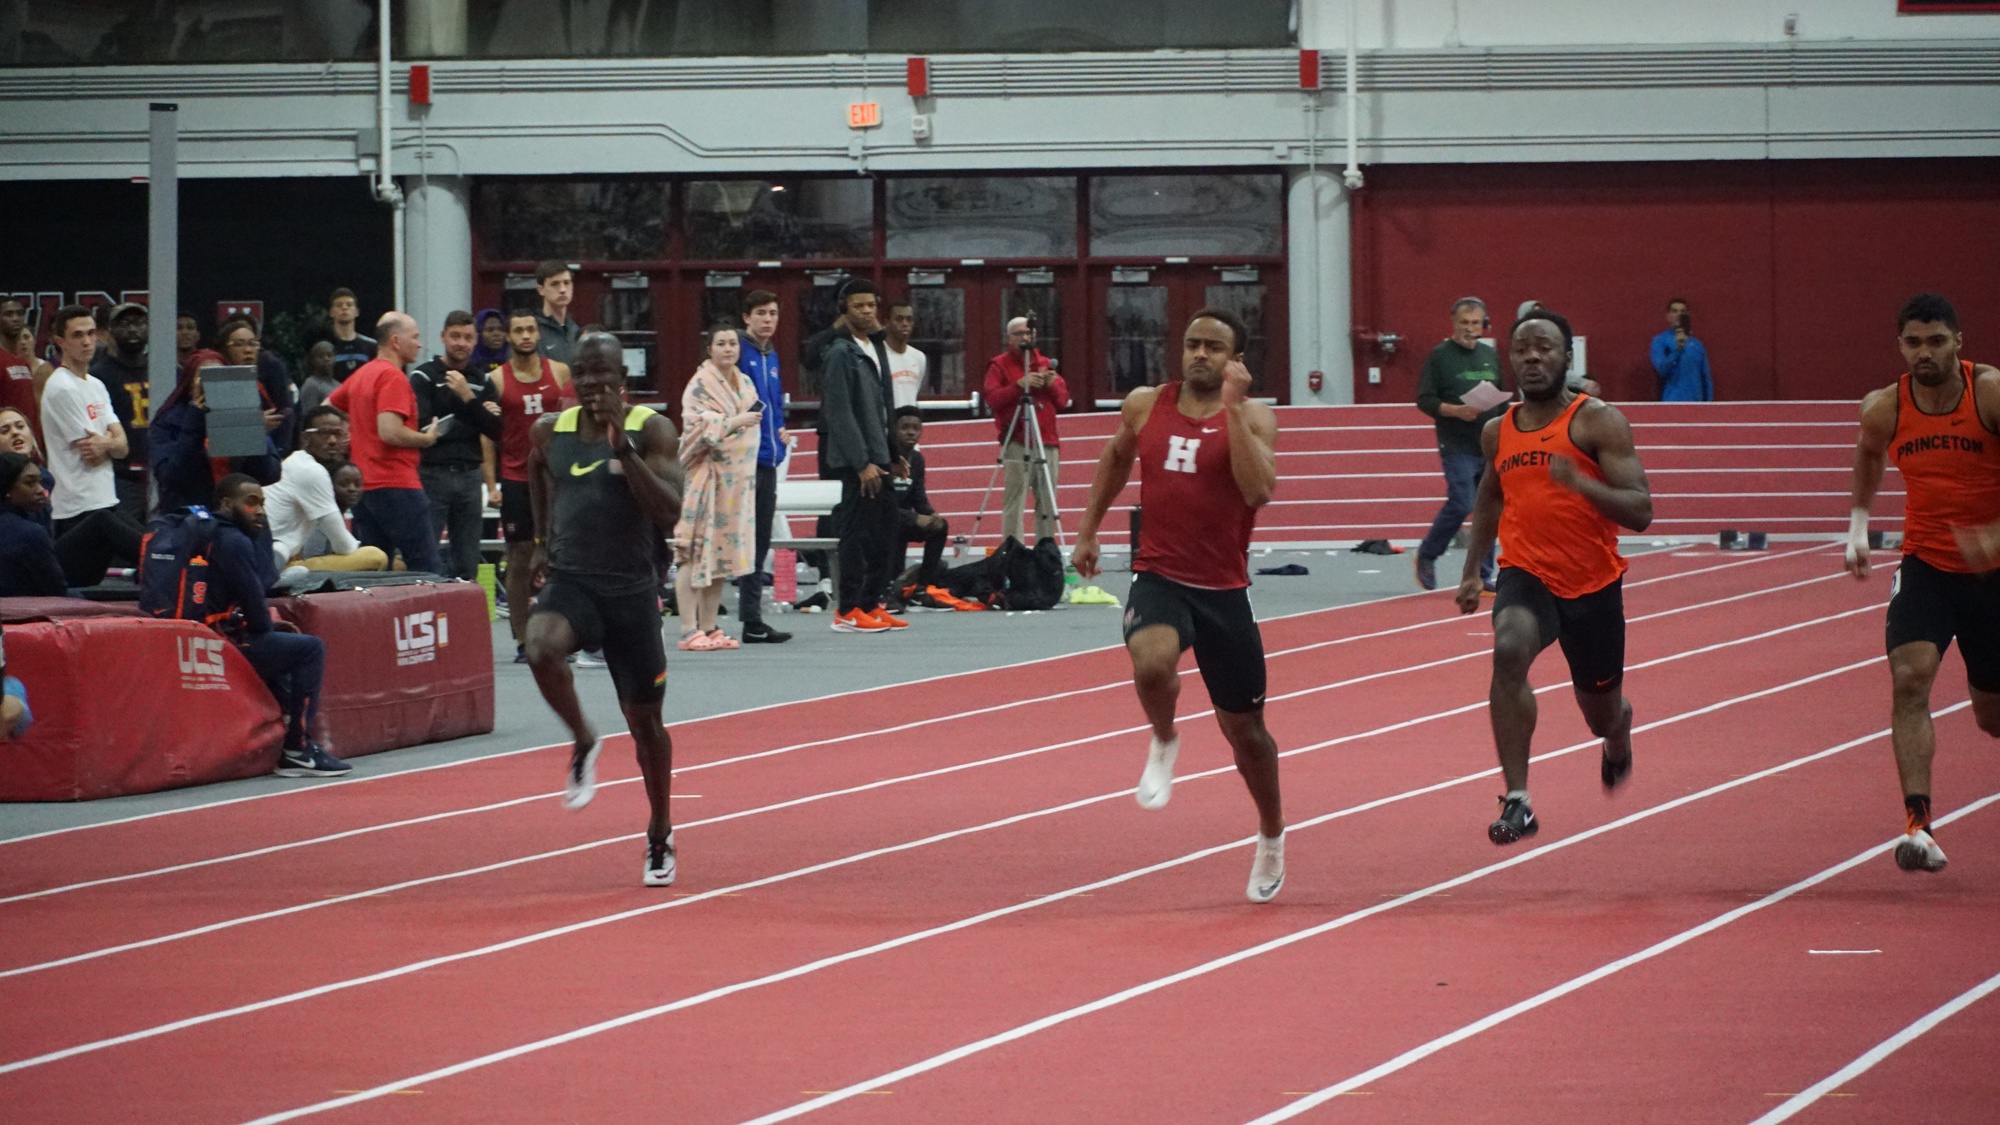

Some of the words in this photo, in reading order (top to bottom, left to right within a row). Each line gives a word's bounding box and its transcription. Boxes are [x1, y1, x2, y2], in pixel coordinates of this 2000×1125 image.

[851, 103, 877, 125] EXIT
[522, 393, 544, 415] H
[1163, 435, 1202, 474] H
[1897, 434, 1984, 462] PRINCETON
[393, 610, 436, 652] UCS
[177, 635, 226, 676] UCS
